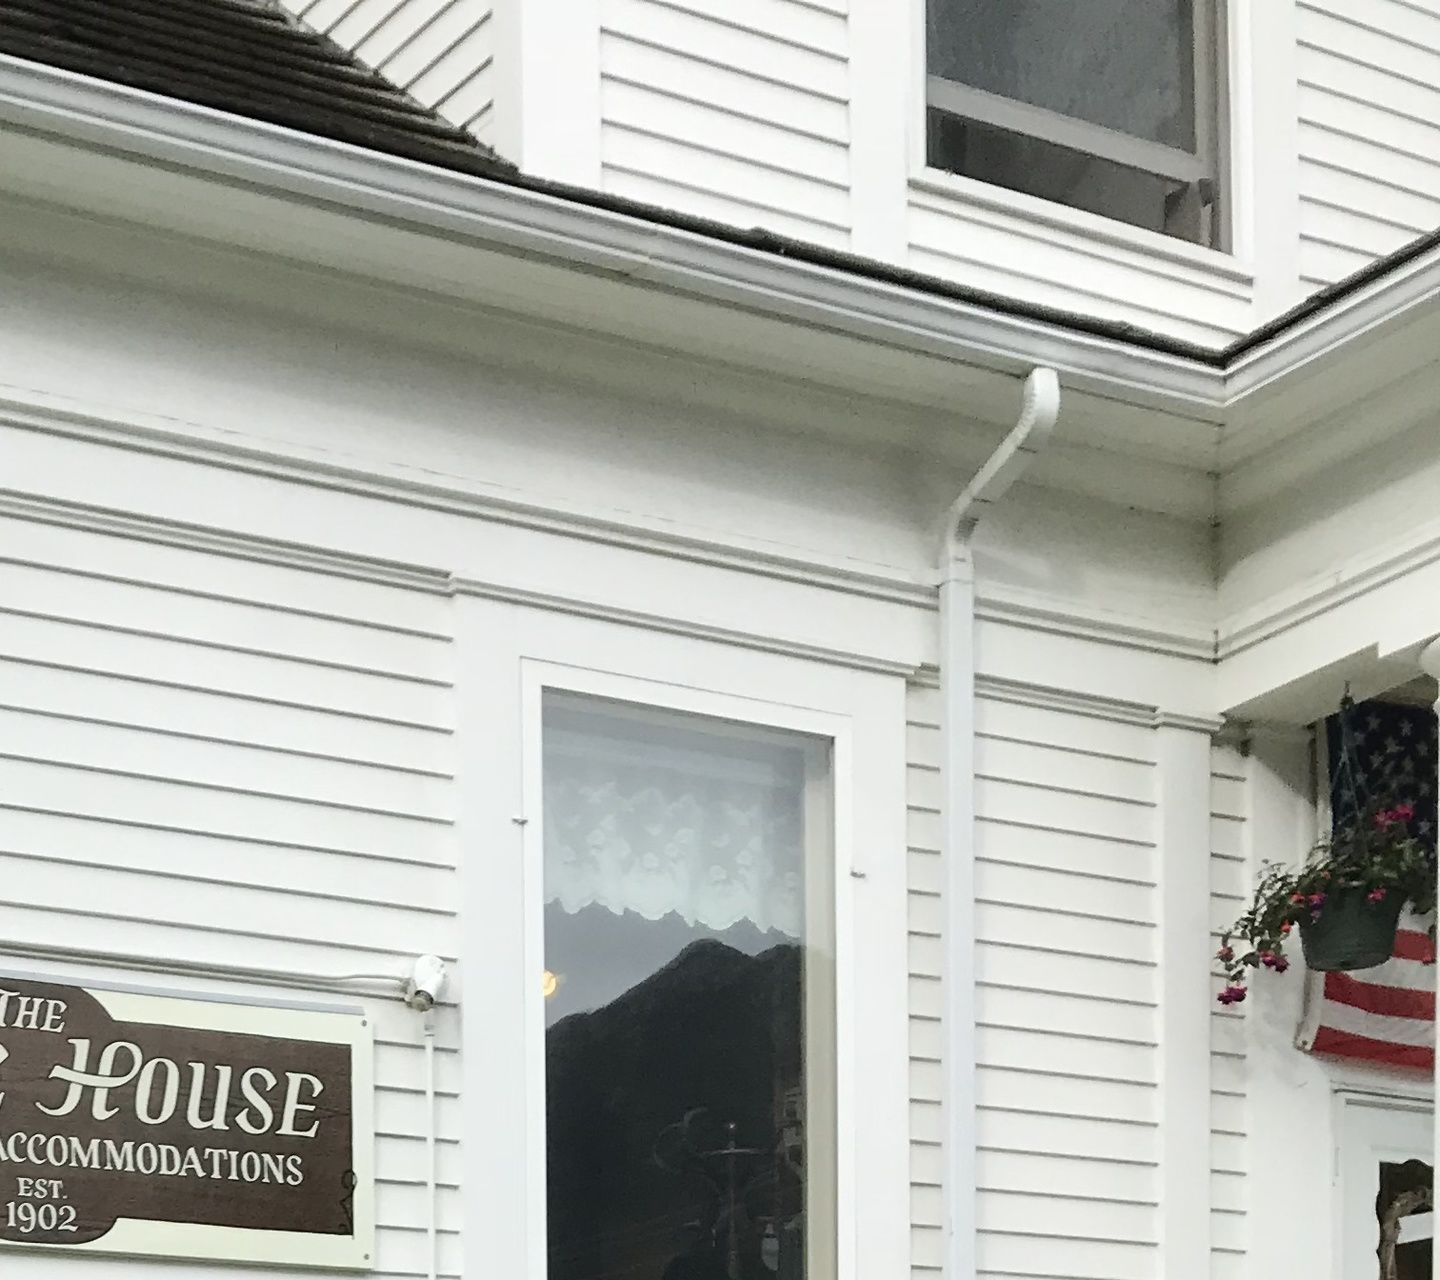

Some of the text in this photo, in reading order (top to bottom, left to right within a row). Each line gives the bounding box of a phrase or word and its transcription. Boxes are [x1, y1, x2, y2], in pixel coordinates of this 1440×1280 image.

[35, 1038, 324, 1138] HOUSE
[17, 1177, 68, 1202] EST.
[6, 1201, 80, 1234] 1902
